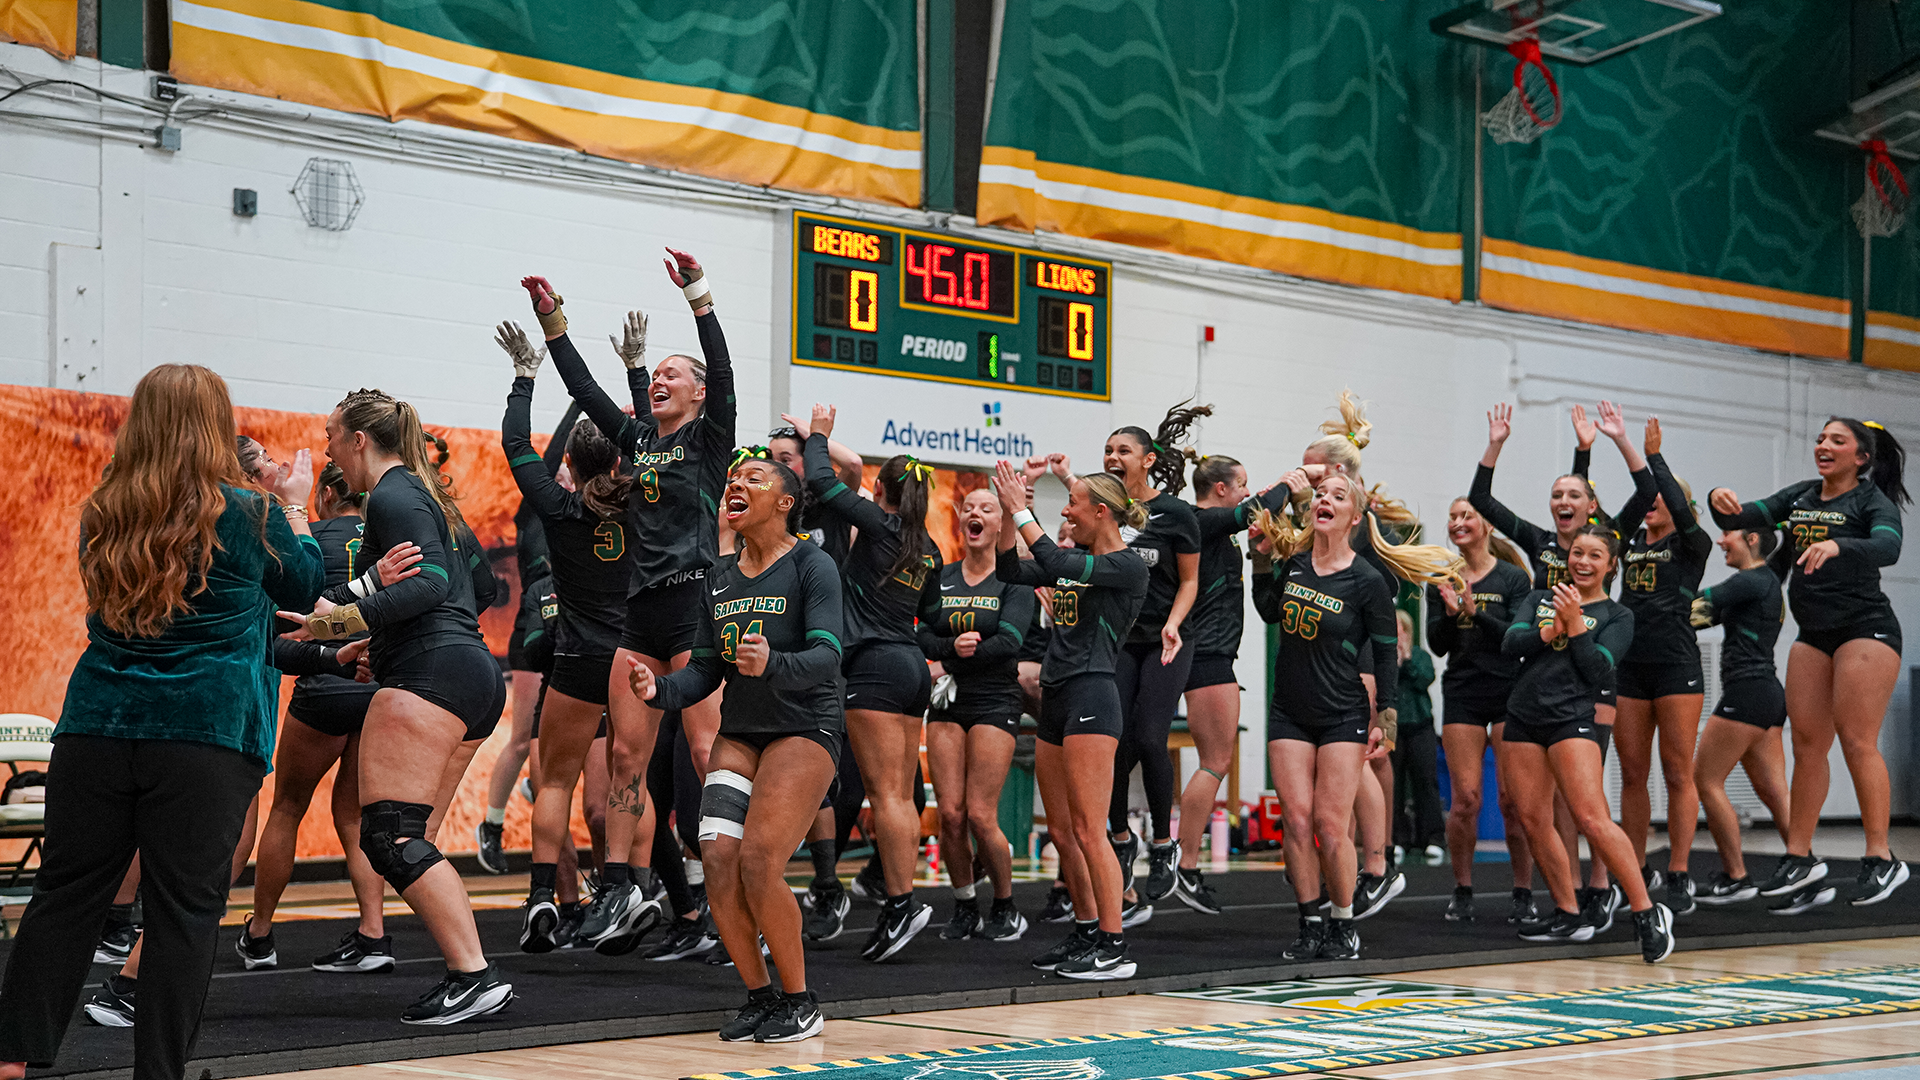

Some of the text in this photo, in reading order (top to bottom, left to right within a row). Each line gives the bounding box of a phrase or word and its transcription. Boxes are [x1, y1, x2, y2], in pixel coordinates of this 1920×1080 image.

[813, 225, 881, 262] BEARS
[906, 243, 990, 311] 45.0
[1036, 261, 1096, 295] LIONS
[850, 269, 879, 333] 0
[900, 334, 968, 363] PERIOD
[1068, 302, 1094, 361] 0
[988, 334, 999, 379] 1
[881, 420, 1034, 459] AdventHealth
[639, 467, 661, 504] 9
[593, 521, 626, 562] 3
[666, 568, 705, 587] NIKE
[1625, 563, 1656, 592] 44
[714, 596, 787, 621] SAINT LEO
[971, 596, 1000, 611] LEO
[1282, 600, 1323, 641] 35
[1313, 592, 1345, 615] LEO
[720, 619, 763, 664] 34
[949, 611, 976, 635] 11
[27, 726, 53, 736] LEO
[1151, 1004, 1634, 1059] SAINT
[1563, 985, 1861, 1017] LEO
